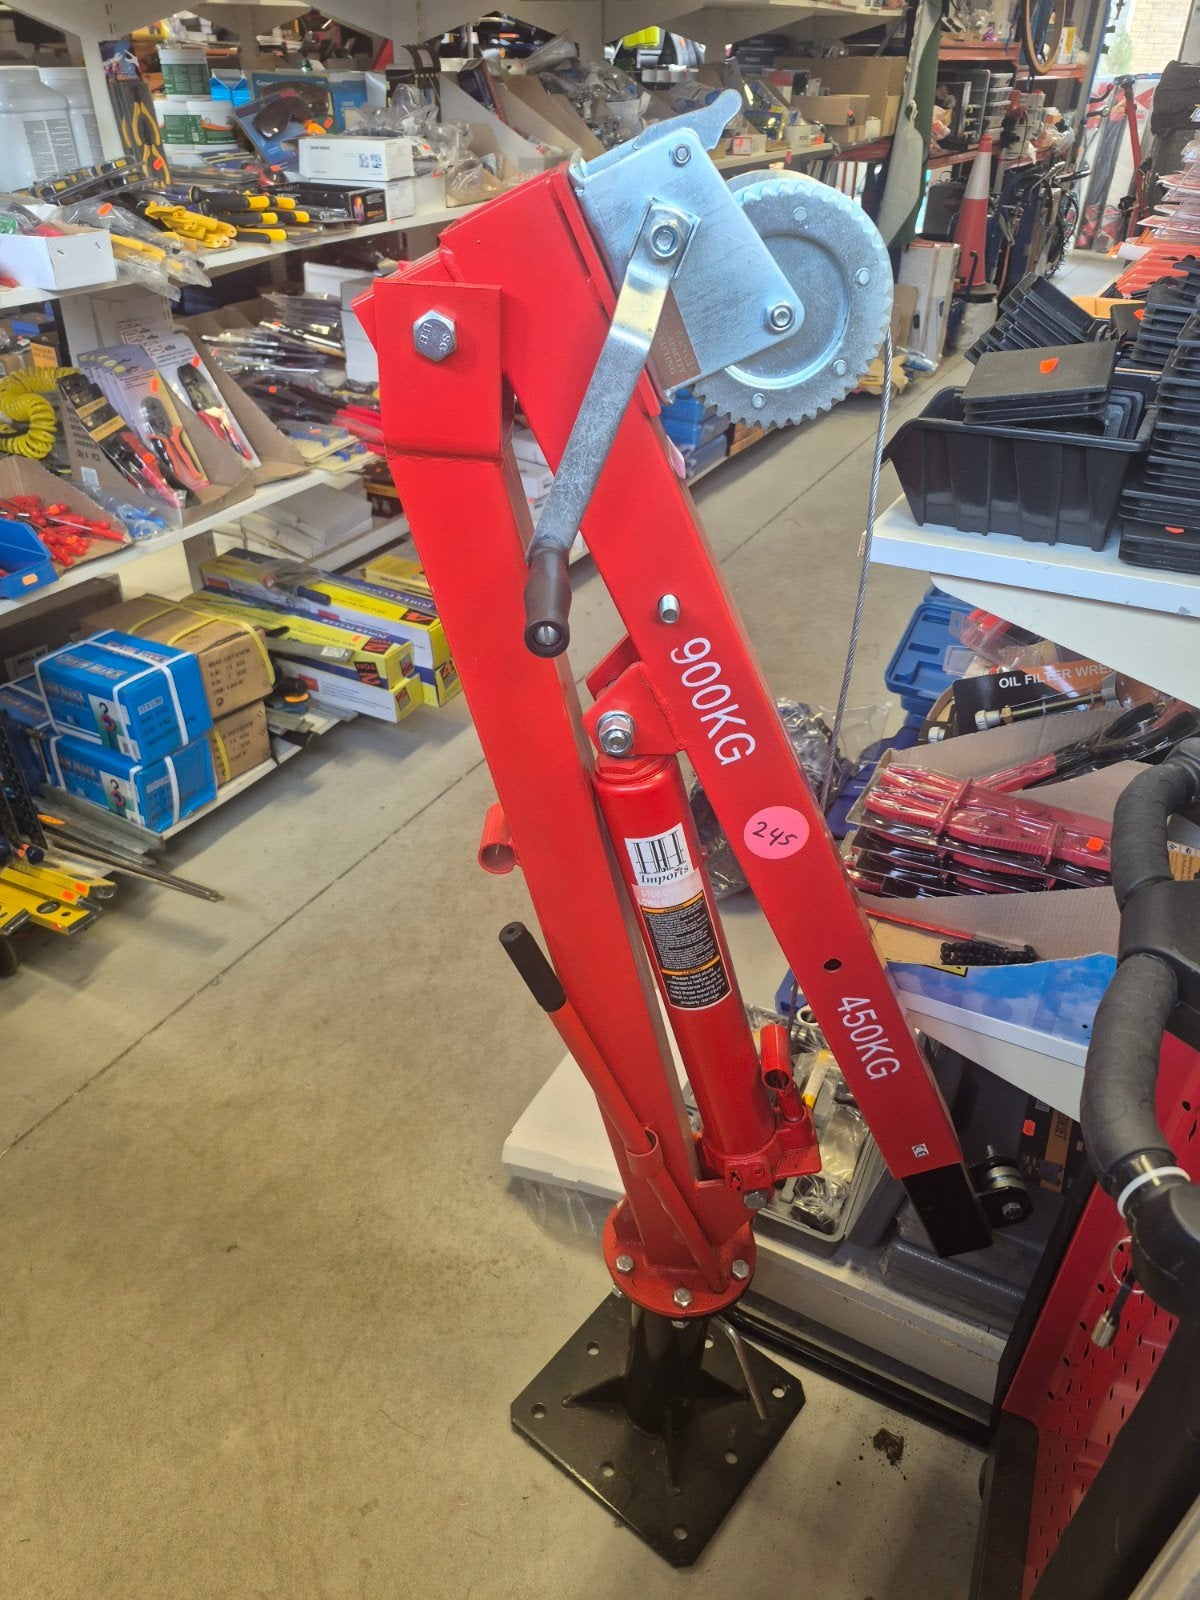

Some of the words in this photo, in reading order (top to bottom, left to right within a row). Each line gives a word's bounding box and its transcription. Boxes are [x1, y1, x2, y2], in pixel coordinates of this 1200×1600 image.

[361, 672, 382, 686] 2
[998, 678, 1021, 689] OIL
[670, 637, 756, 766] 900KG
[752, 821, 798, 847] 245
[640, 866, 690, 886] Imports
[838, 996, 901, 1080] 450KG
